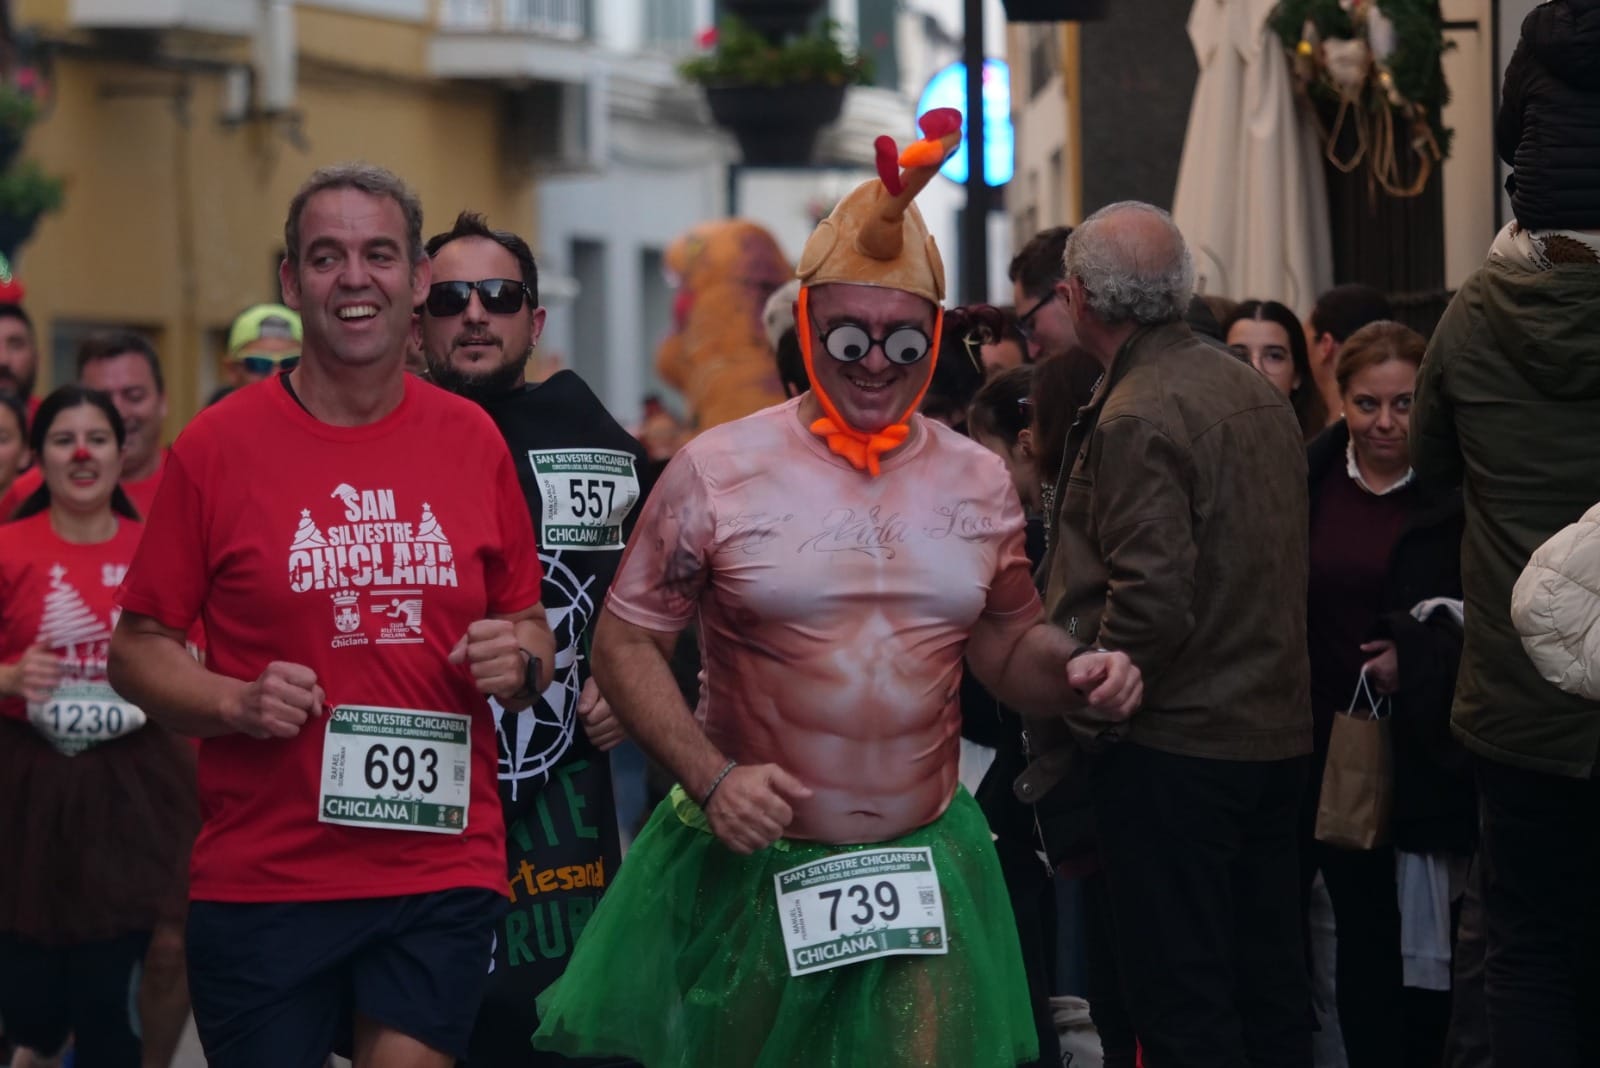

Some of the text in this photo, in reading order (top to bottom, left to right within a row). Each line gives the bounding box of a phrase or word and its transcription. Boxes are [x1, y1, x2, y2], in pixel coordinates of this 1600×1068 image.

[535, 453, 630, 467] SAN SILVESTRE CHICLANERA
[344, 488, 397, 523] SAN
[544, 480, 553, 503] CARLOS
[569, 479, 616, 519] 557
[327, 521, 415, 546] SILVESTRE
[547, 527, 598, 542] CHICLANA
[288, 542, 459, 593] CHICLANA
[331, 636, 369, 649] Chiclana
[48, 704, 123, 735] 1230
[334, 711, 466, 732] SAN SILVESTRE CHICLANERA
[331, 752, 340, 780] RAFAEL
[364, 743, 439, 795] 693
[326, 799, 409, 821] CHICLANA
[783, 852, 926, 885] SAN SILVESTRE CHICLANERA
[818, 880, 901, 932] 739
[797, 935, 877, 966] CHICLANA
